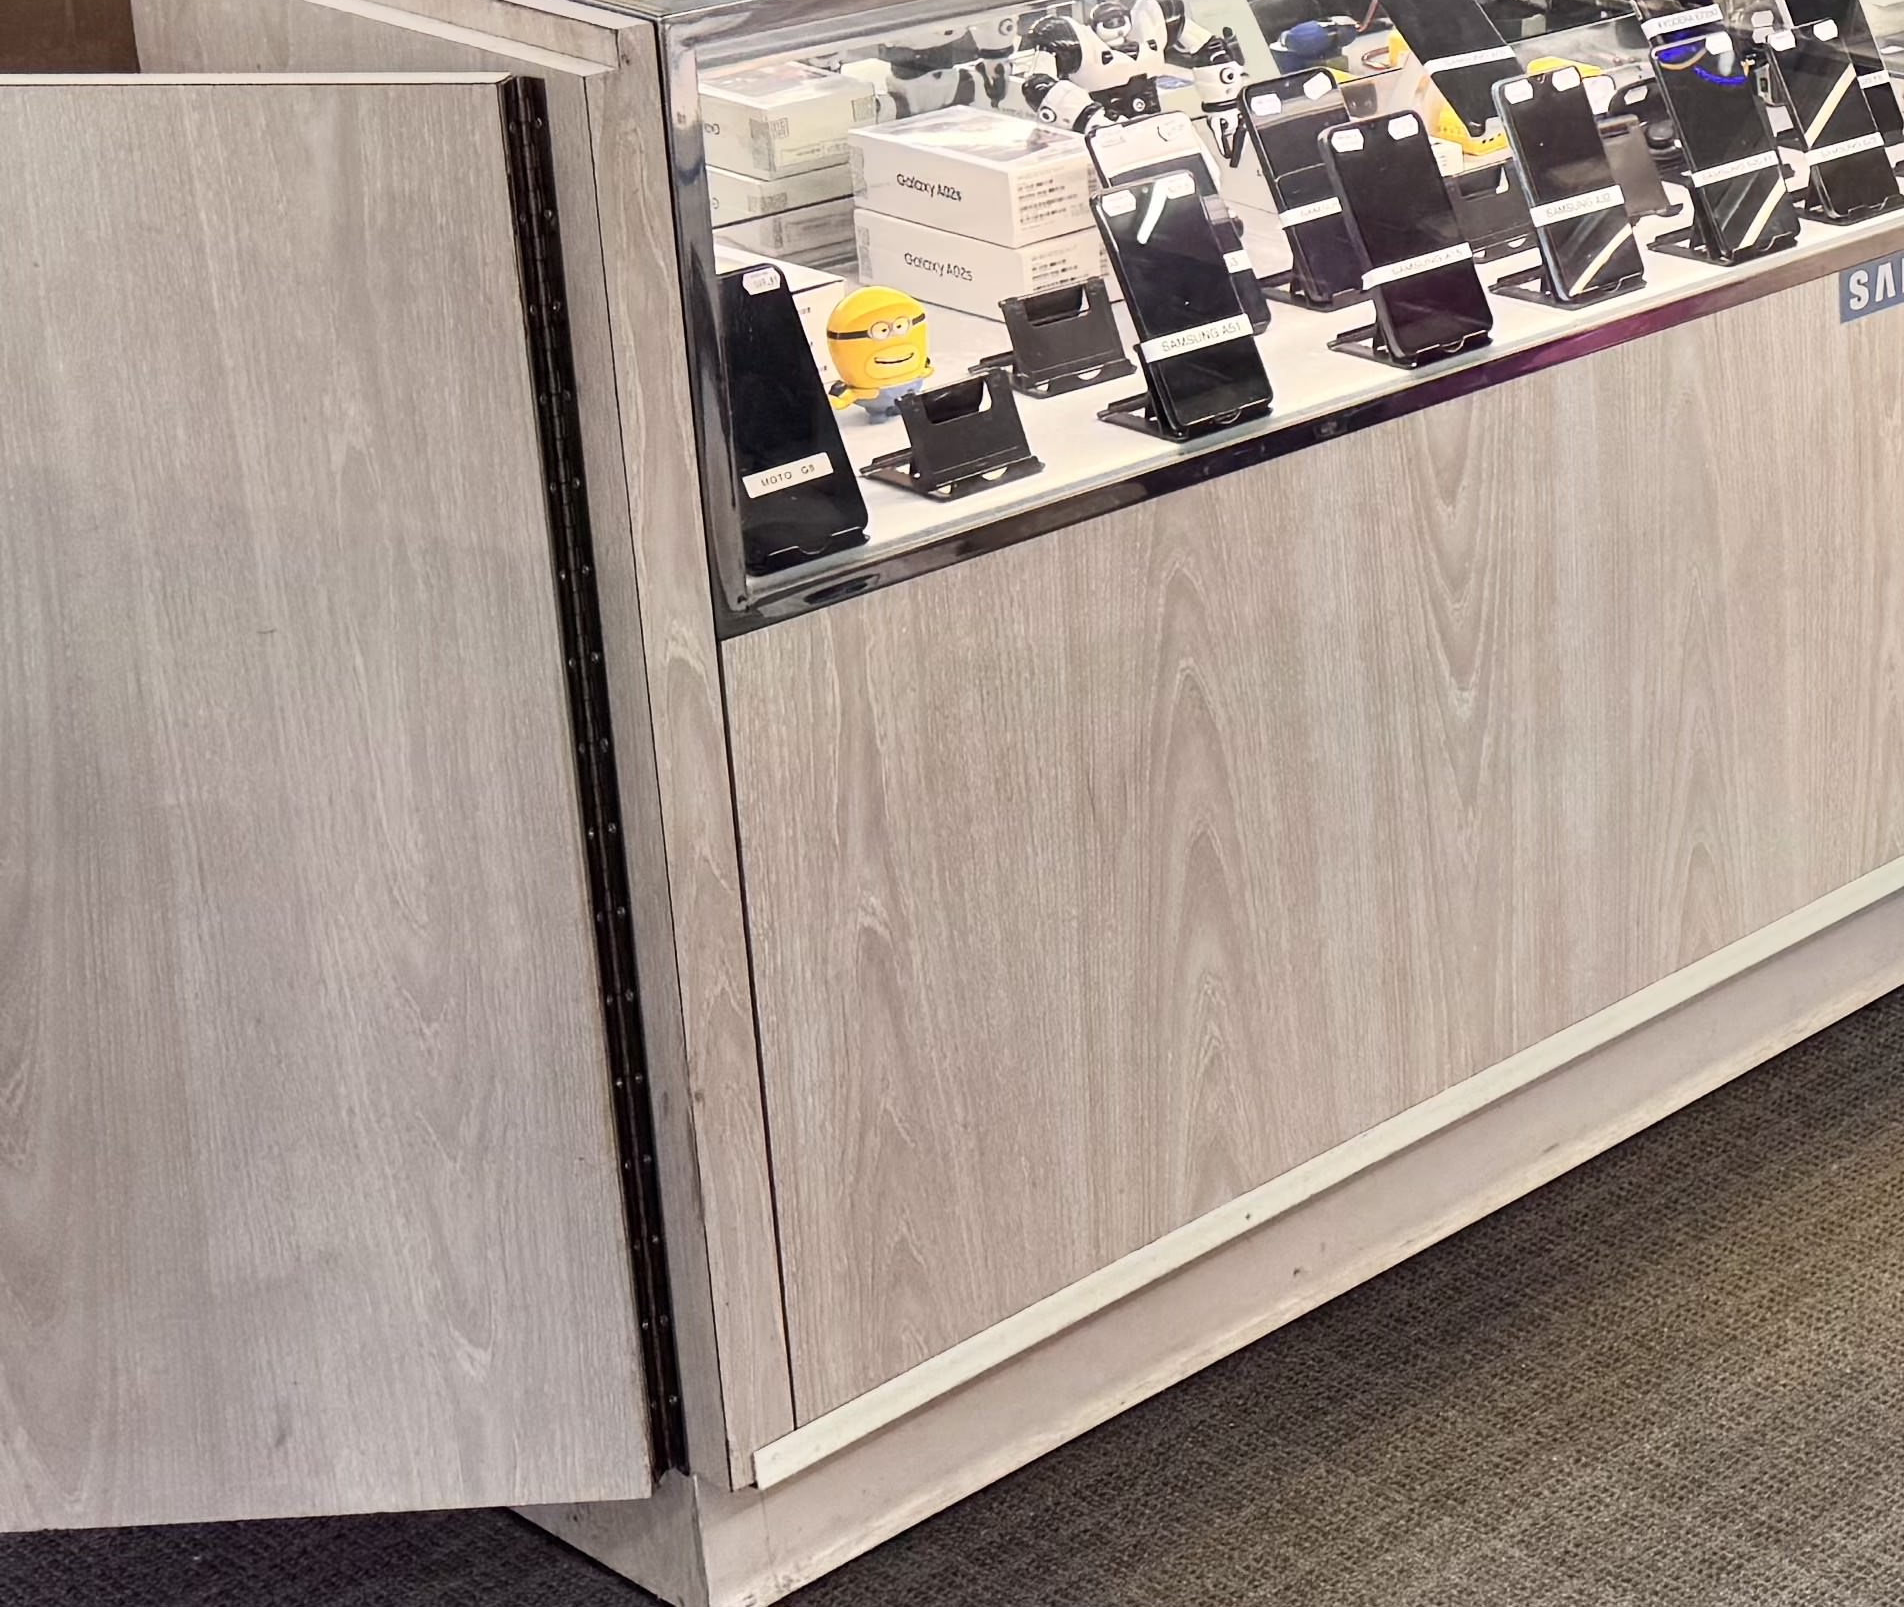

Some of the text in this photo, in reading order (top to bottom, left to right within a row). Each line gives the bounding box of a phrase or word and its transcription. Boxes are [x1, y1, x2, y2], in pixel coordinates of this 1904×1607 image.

[895, 172, 934, 200] Galaxy
[903, 252, 943, 280] Galaxy
[1160, 329, 1219, 353] SAMSUNG
[761, 469, 794, 489] MOTO
